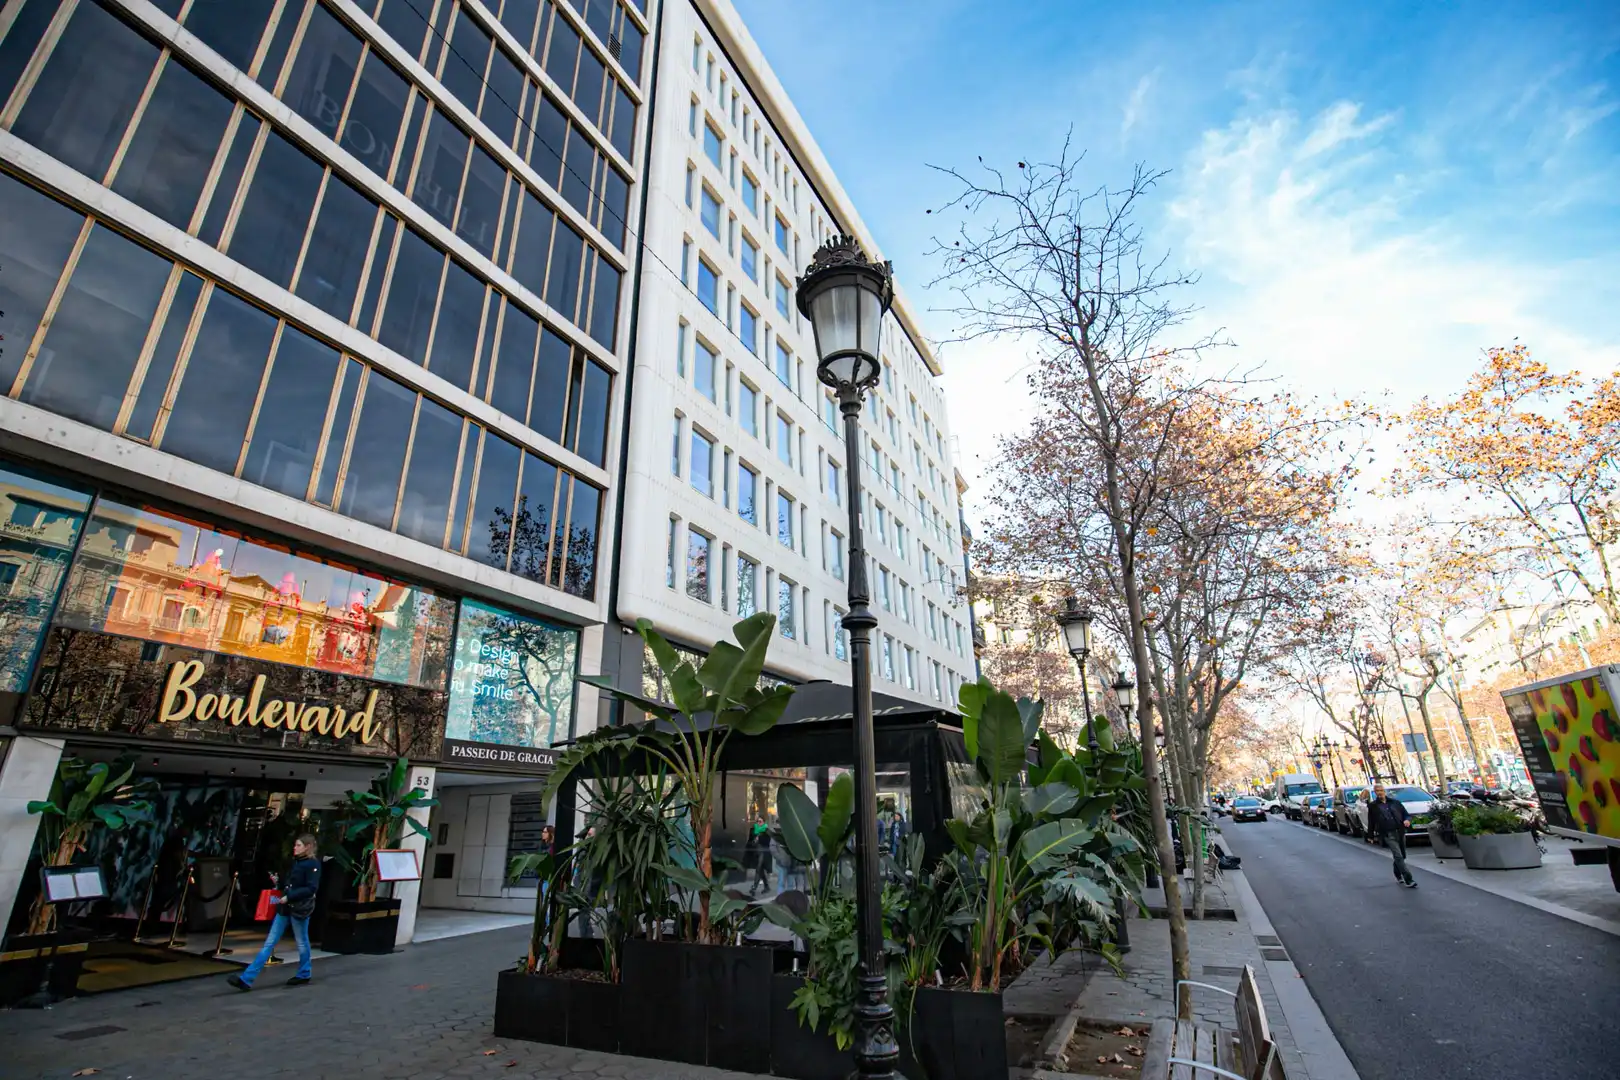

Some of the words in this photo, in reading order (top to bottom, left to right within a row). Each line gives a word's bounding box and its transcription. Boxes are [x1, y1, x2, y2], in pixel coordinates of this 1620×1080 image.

[470, 638, 520, 665] Design
[469, 660, 509, 680] make
[159, 659, 382, 745] Boulevard
[451, 745, 498, 761] PASSEIG
[500, 750, 516, 762] DE
[517, 752, 554, 765] GRACIA
[416, 775, 430, 787] 53
